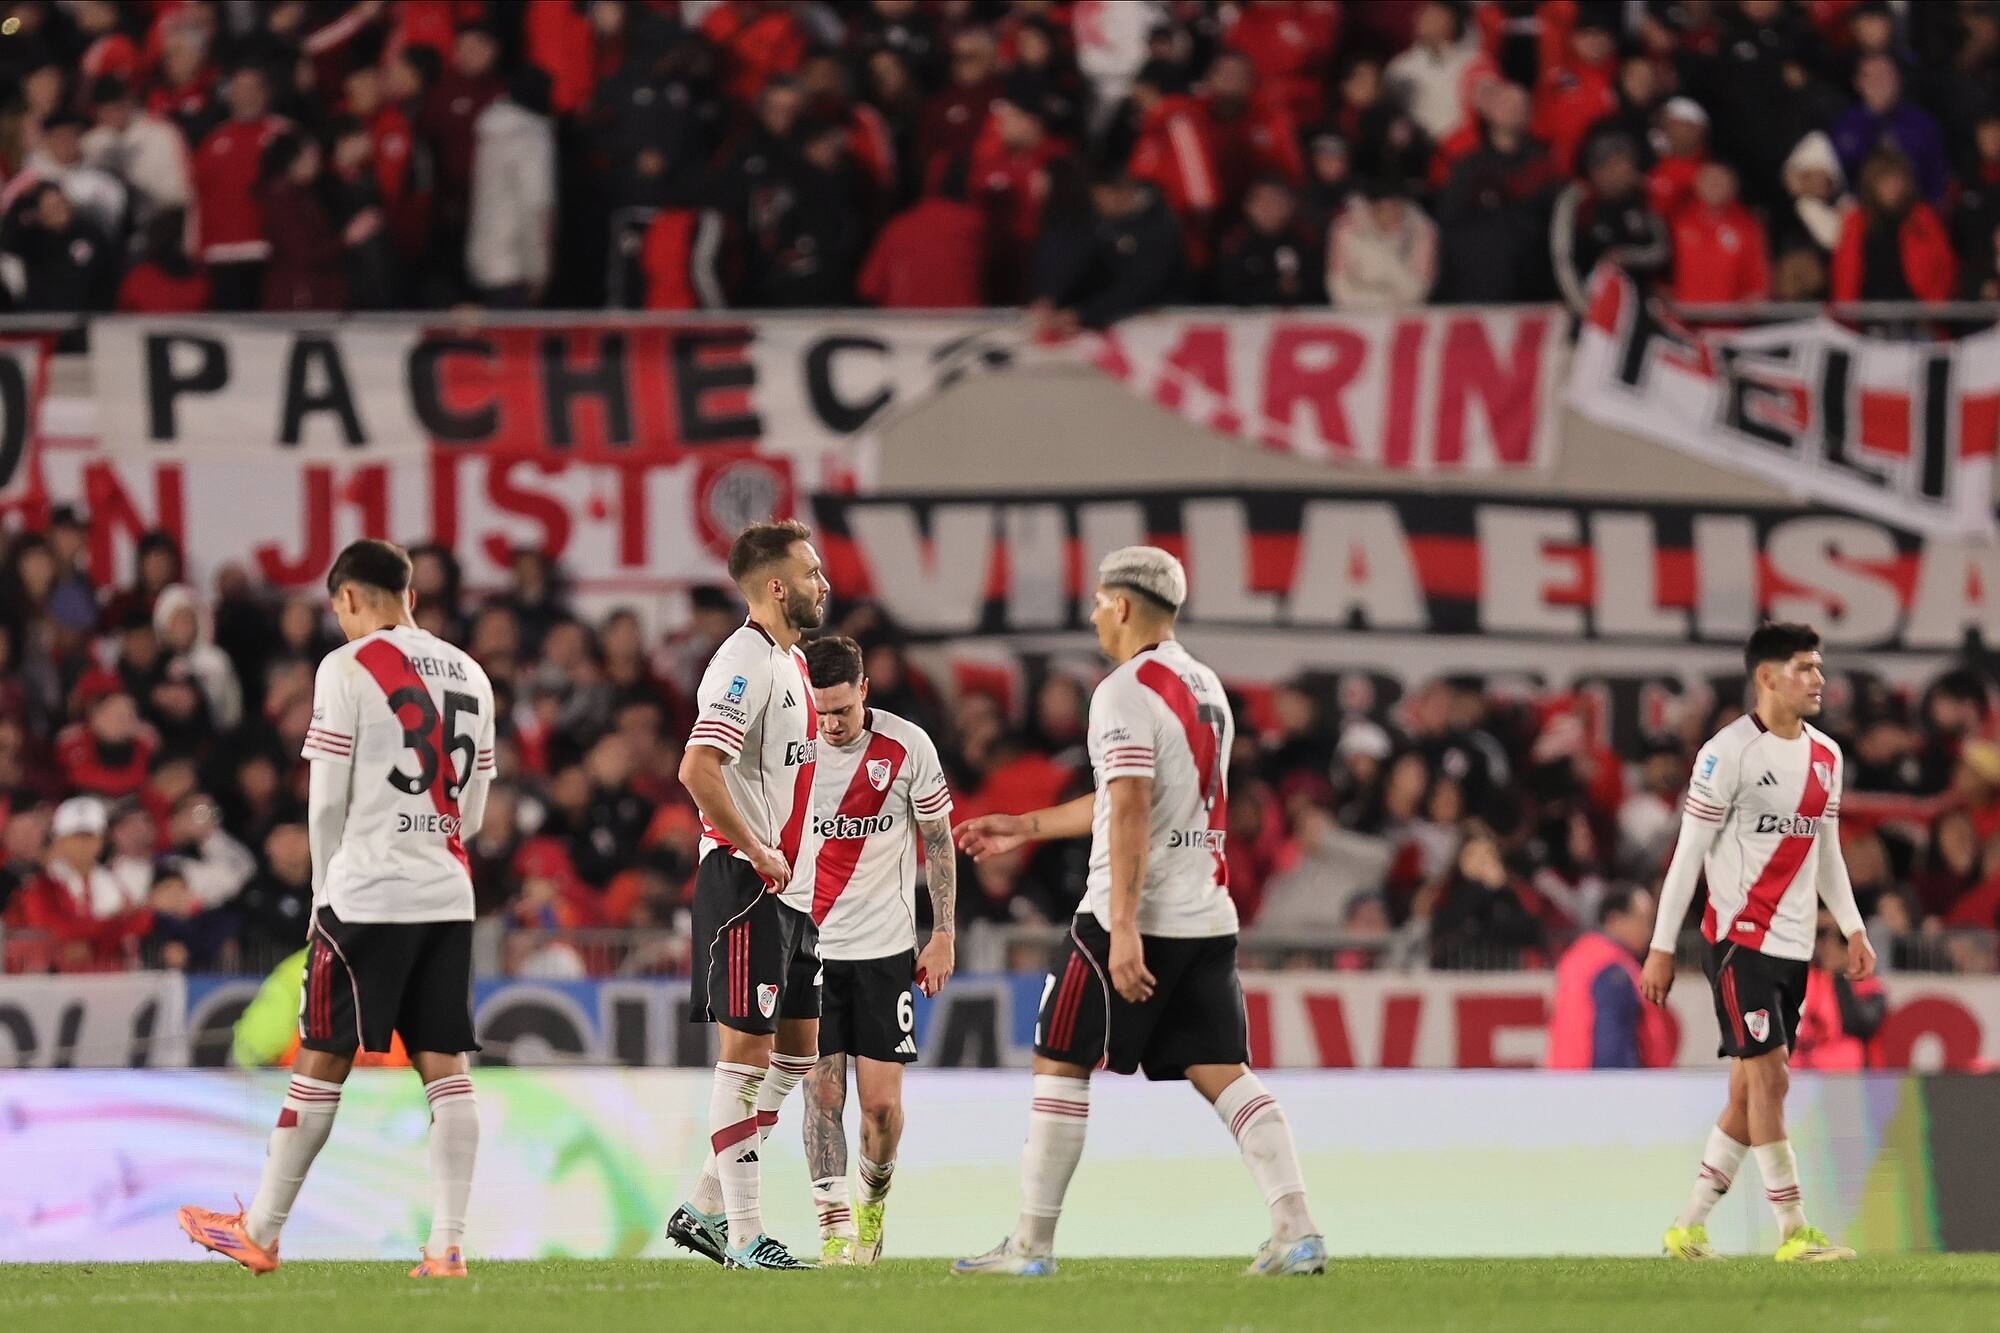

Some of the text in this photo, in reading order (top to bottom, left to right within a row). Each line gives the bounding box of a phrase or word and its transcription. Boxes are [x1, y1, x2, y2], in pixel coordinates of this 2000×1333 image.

[1478, 503, 2000, 649] ELISA
[402, 655, 468, 682] FREITAS
[709, 702, 747, 716] ASSIST
[719, 710, 746, 725] CARD
[386, 687, 479, 800] 35
[1197, 702, 1226, 811] 7
[896, 990, 914, 1033] 6
